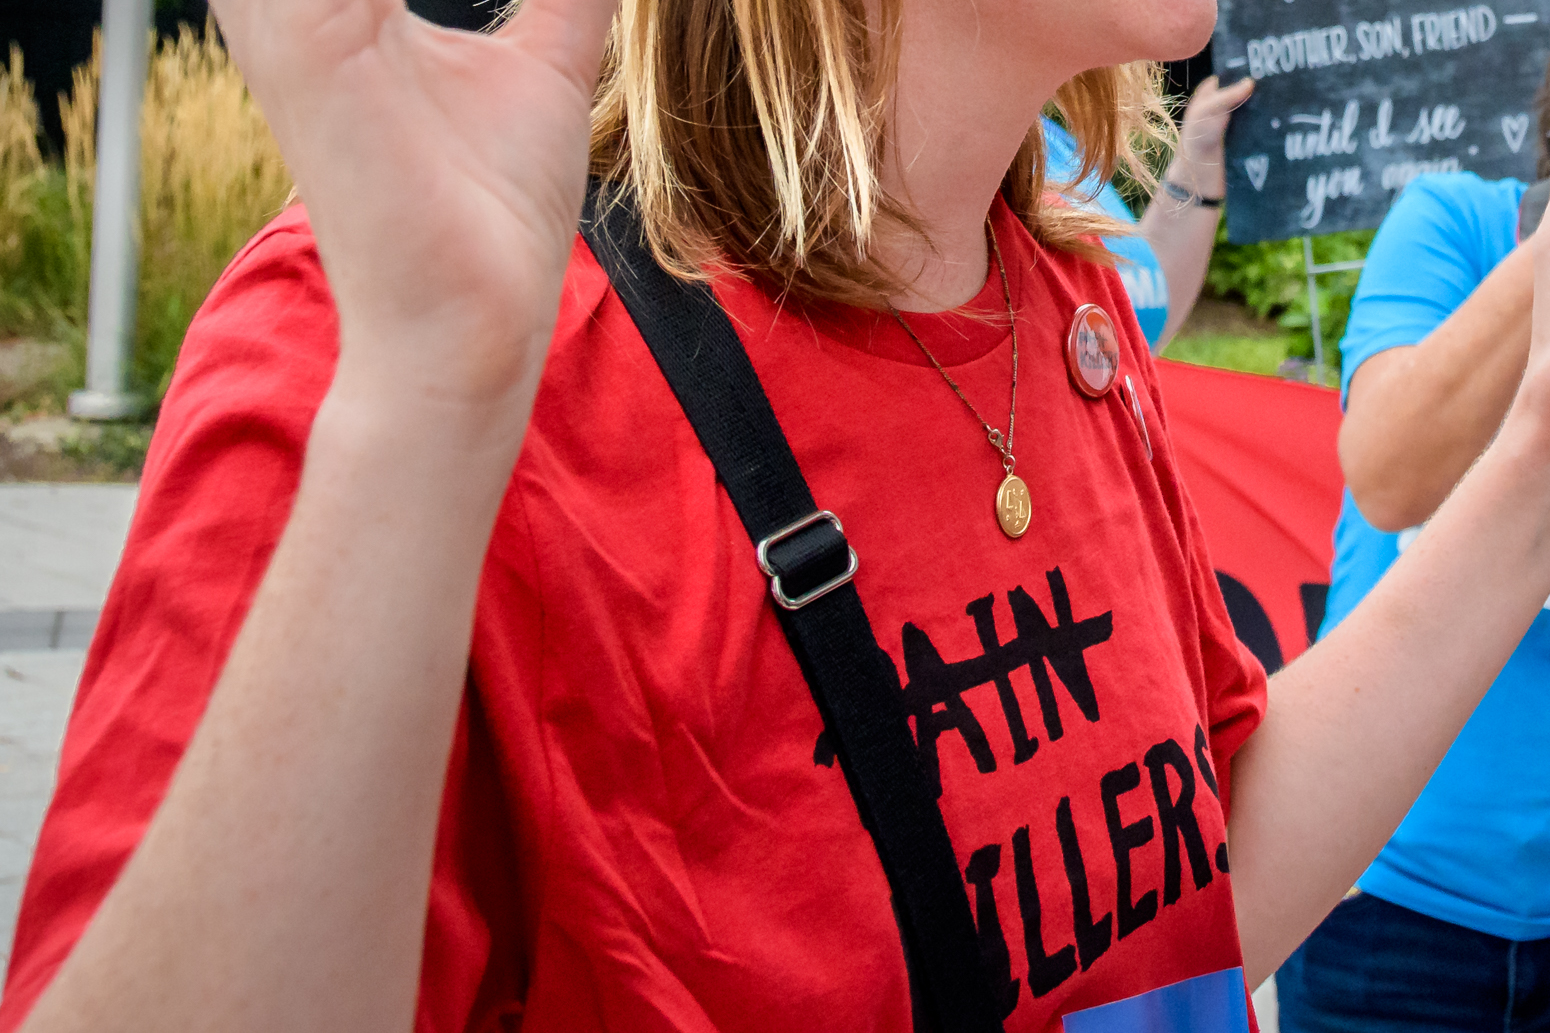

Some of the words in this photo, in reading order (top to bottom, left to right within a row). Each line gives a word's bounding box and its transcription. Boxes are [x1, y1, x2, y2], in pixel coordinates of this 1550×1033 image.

[1411, 4, 1497, 55] FRIEND
[1284, 99, 1360, 160] until
[1406, 104, 1466, 144] see
[1301, 166, 1365, 229] you
[900, 565, 1113, 800] AIN
[964, 723, 1231, 1021] ILLER
